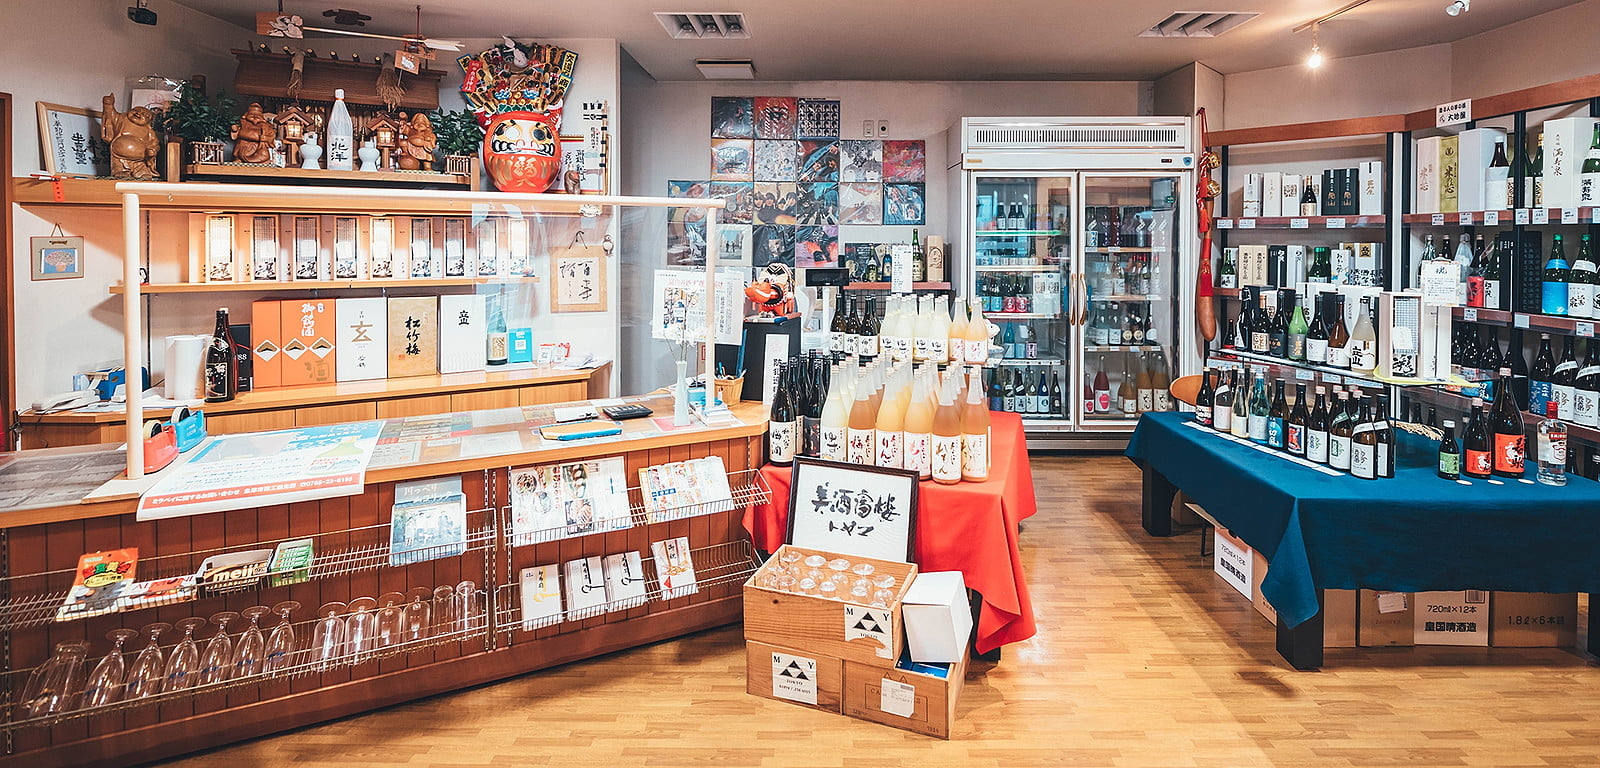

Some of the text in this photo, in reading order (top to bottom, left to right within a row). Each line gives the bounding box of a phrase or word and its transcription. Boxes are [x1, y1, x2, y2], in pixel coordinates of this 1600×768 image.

[330, 141, 349, 162] 北洋
[350, 320, 373, 343] 玄
[404, 315, 421, 356] 松竹梅
[824, 431, 841, 453] ゆず
[404, 484, 437, 496] 川っぺり
[829, 520, 874, 537] トヤマ
[212, 564, 255, 583] meiji
[846, 607, 890, 622] M Y
[1424, 622, 1477, 633] 皇国晴酒造
[773, 655, 815, 670] M Y
